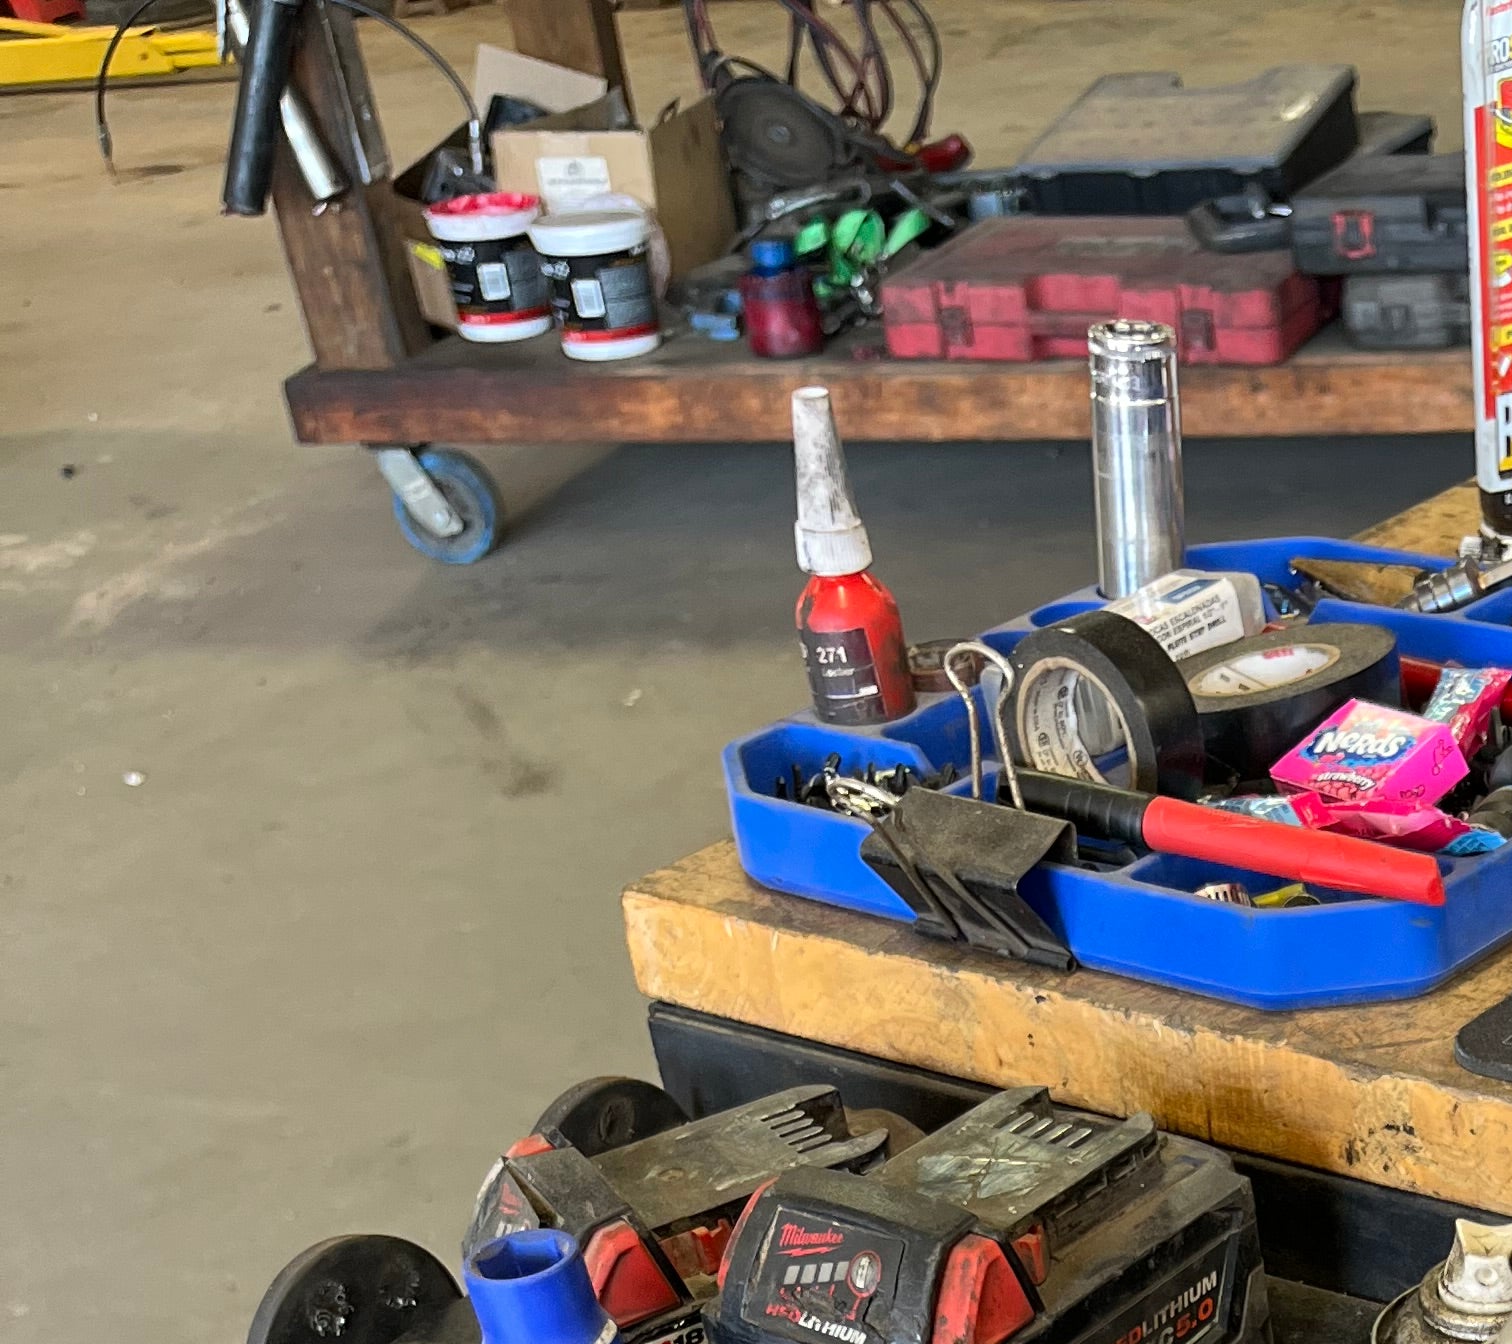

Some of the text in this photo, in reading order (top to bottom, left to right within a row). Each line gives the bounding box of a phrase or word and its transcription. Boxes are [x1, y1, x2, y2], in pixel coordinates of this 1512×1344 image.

[815, 646, 848, 664] 271
[1316, 771, 1377, 791] strawberry
[778, 1222, 845, 1247] Milwaukee
